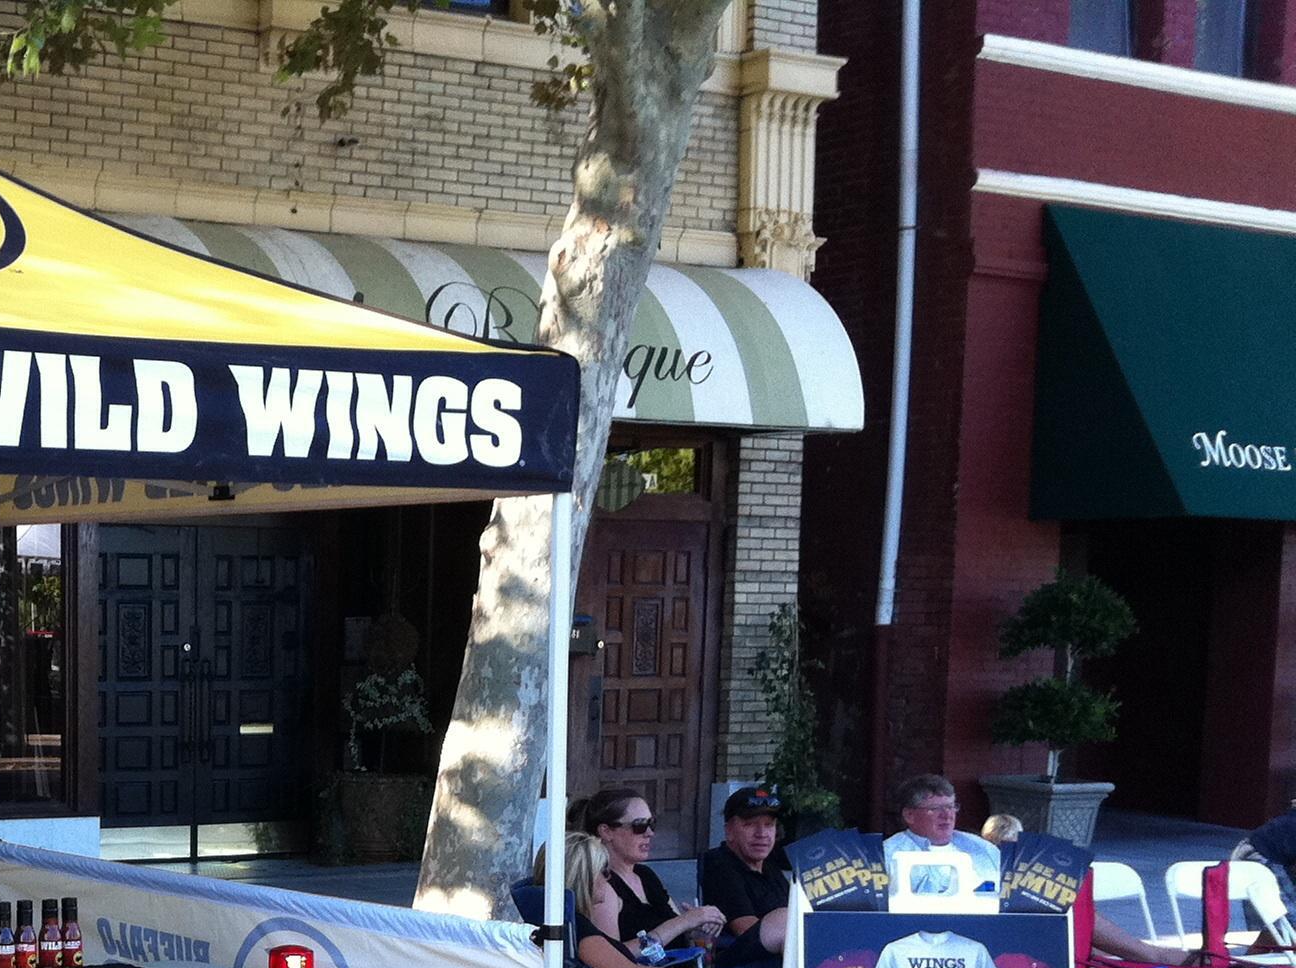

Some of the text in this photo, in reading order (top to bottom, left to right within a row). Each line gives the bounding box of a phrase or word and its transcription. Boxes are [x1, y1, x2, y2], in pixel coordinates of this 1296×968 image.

[623, 343, 714, 408] que
[228, 363, 523, 468] WINGS
[804, 866, 857, 900] MVP
[1019, 871, 1077, 906] MVP
